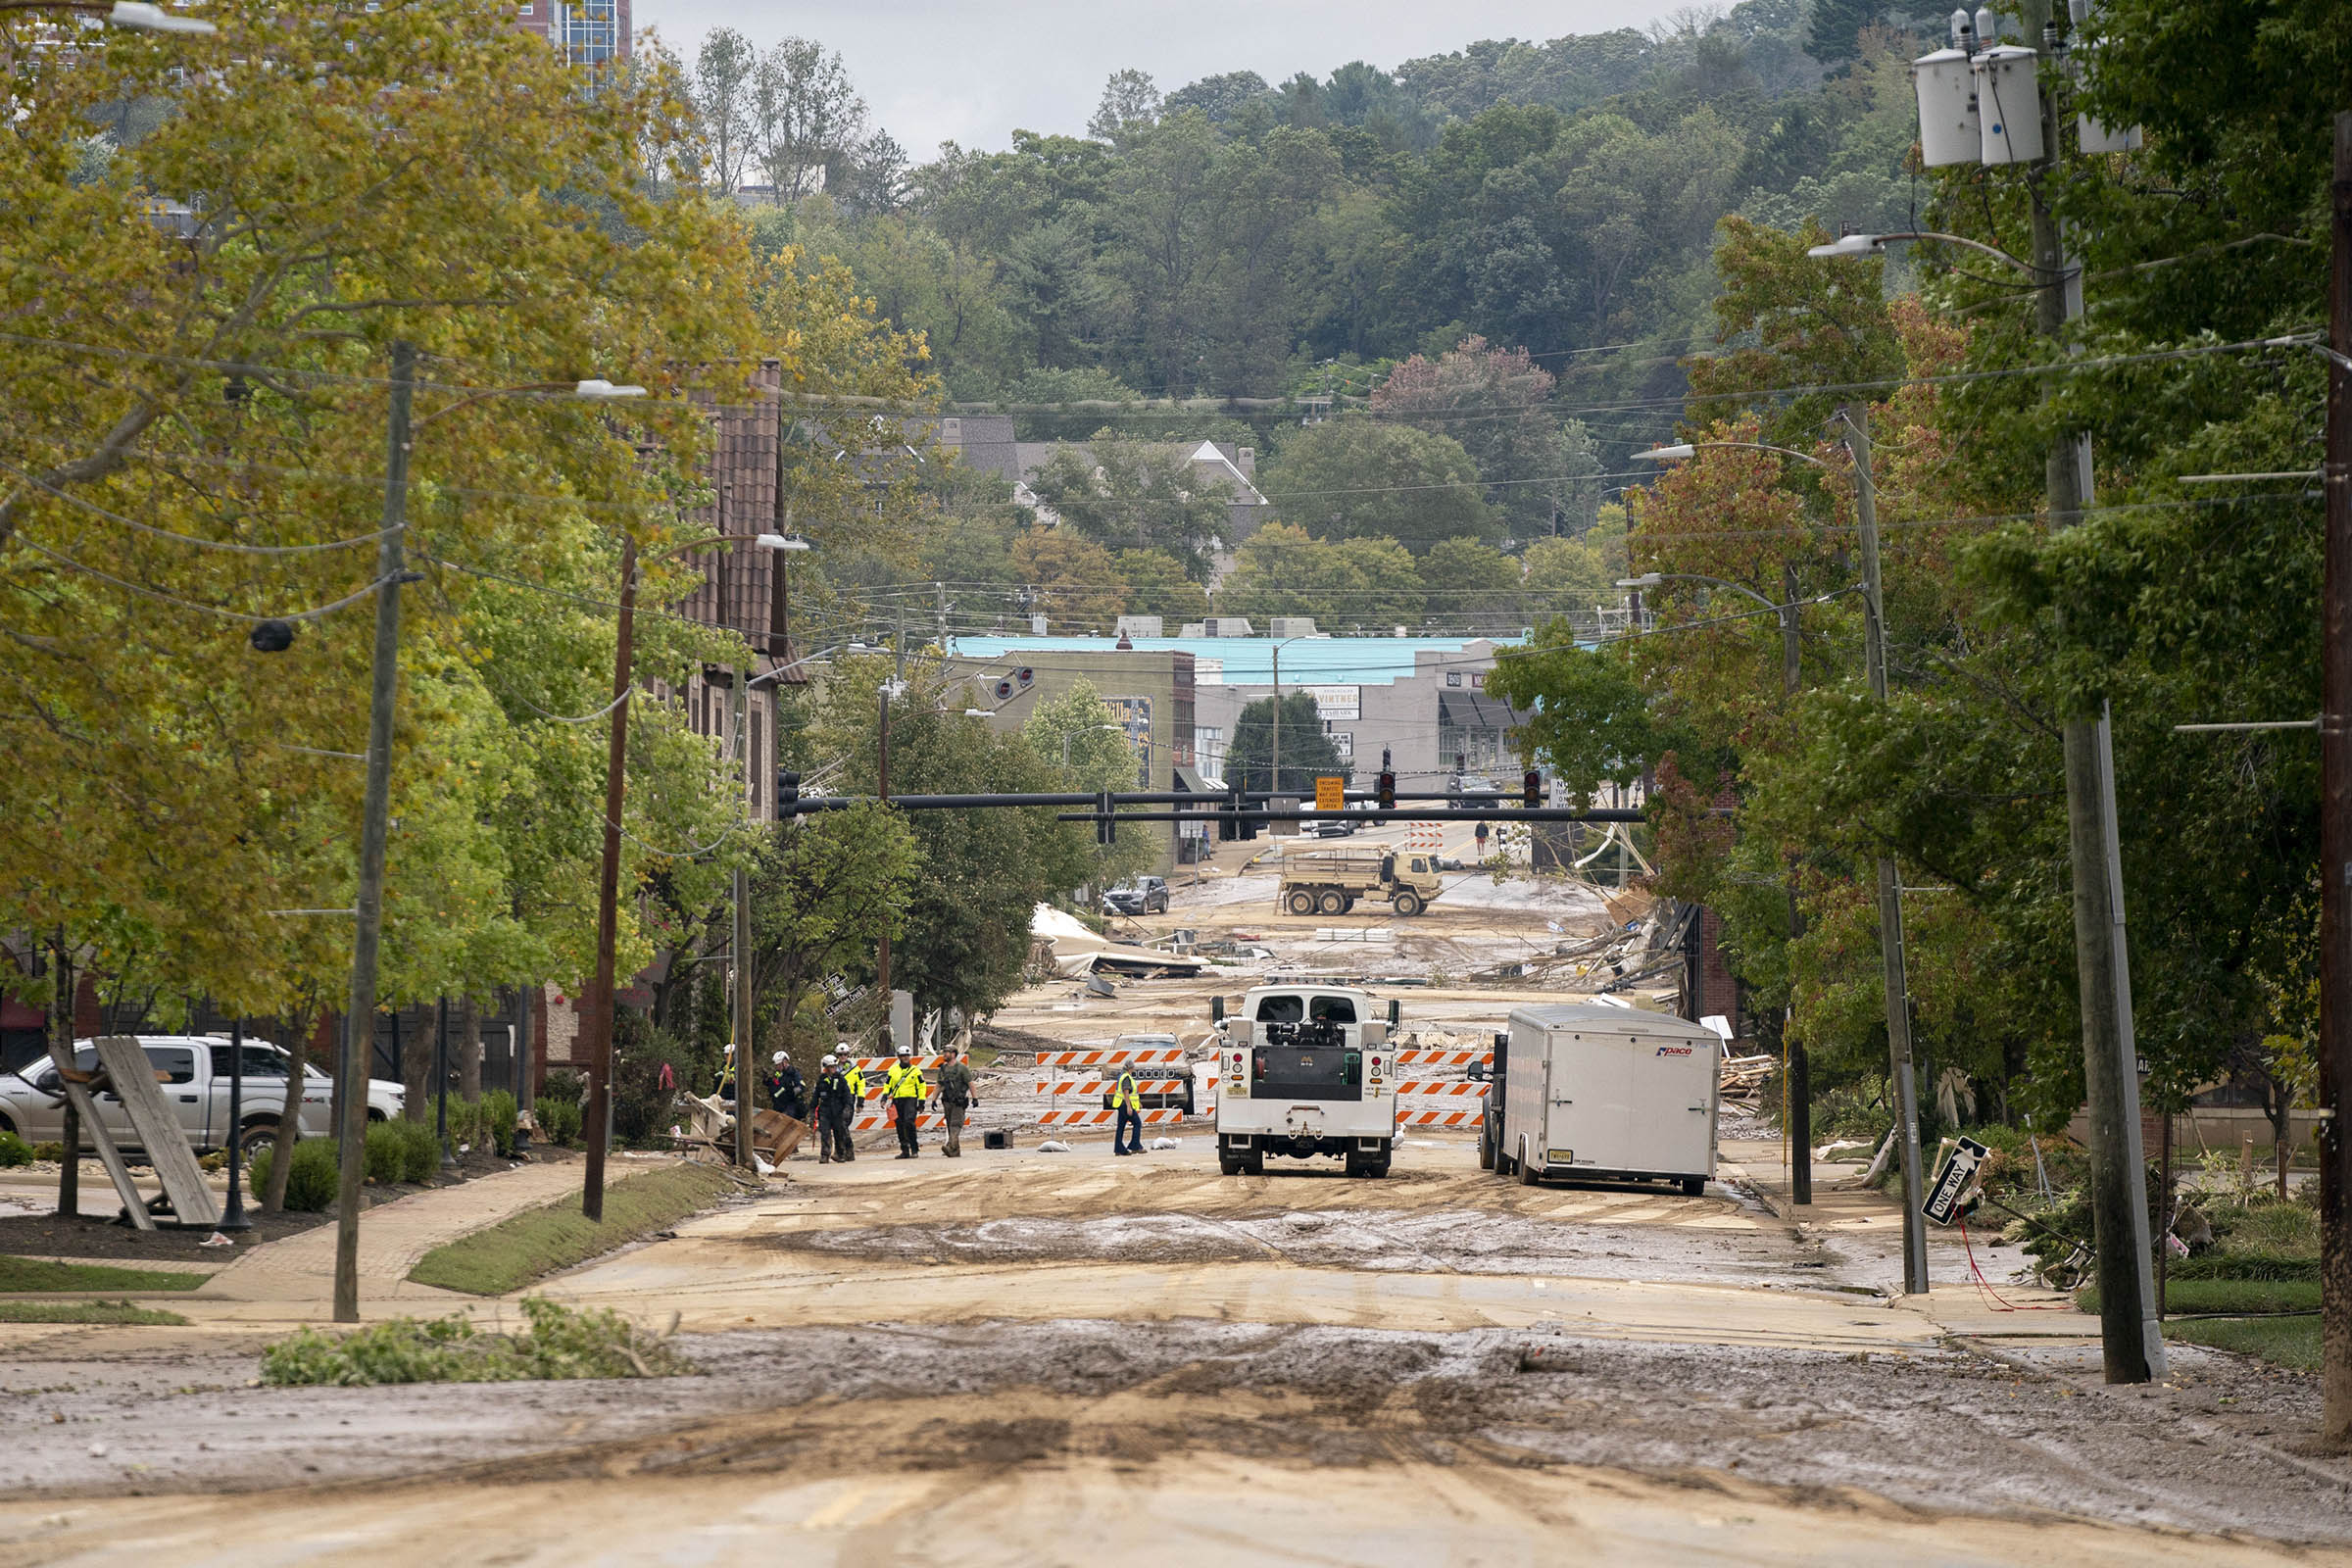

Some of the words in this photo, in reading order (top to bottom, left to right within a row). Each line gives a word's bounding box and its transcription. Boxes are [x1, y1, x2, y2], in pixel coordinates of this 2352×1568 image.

[1318, 694, 1358, 704] VINTNER
[1663, 1047, 1692, 1056] pace
[1934, 1188, 1953, 1213] ONE
[1946, 1163, 1965, 1189] WAY
